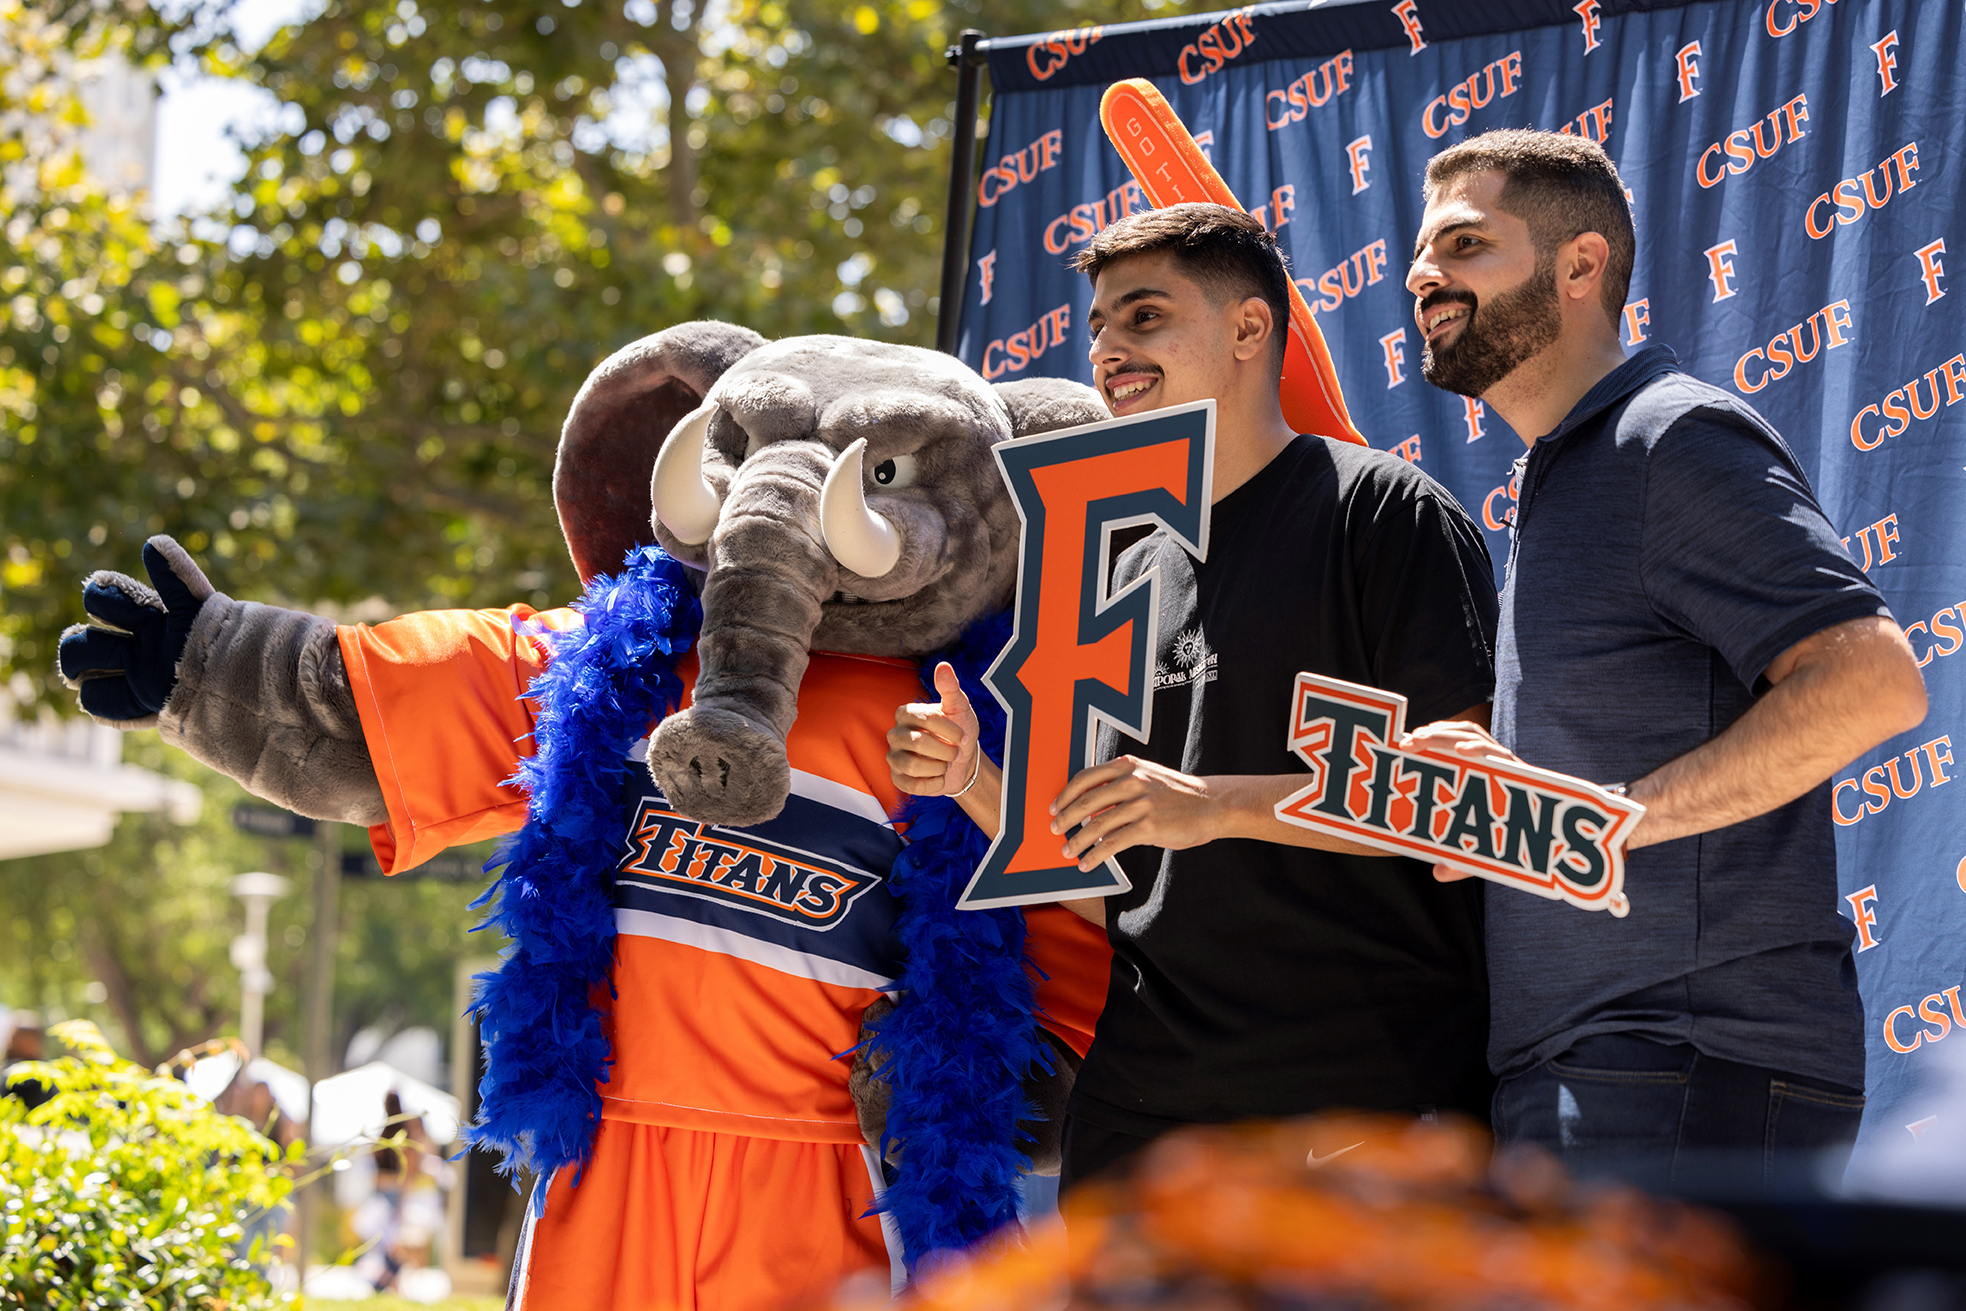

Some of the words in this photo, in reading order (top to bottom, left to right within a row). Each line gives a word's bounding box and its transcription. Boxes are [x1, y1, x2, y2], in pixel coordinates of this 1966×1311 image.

[1266, 49, 1355, 131] CSUF
[1422, 51, 1522, 139] CSUF
[1675, 40, 1702, 103] F
[1869, 29, 1900, 98] F
[978, 129, 1063, 208] CSUF
[1346, 135, 1373, 196] F
[1696, 94, 1809, 189] CSUF
[1805, 142, 1921, 240] CSUF
[977, 249, 997, 307] F
[1704, 239, 1738, 303] F
[1914, 238, 1946, 306] F
[982, 303, 1071, 380] CSUF
[1380, 328, 1408, 390] F
[1733, 299, 1853, 394] CSUF
[1850, 352, 1966, 452] CSUF
[955, 398, 1217, 911] F
[1301, 693, 1611, 889] TITANS
[1832, 735, 1954, 826] CSUF
[632, 812, 847, 917] TITANS
[1845, 884, 1879, 953] F
